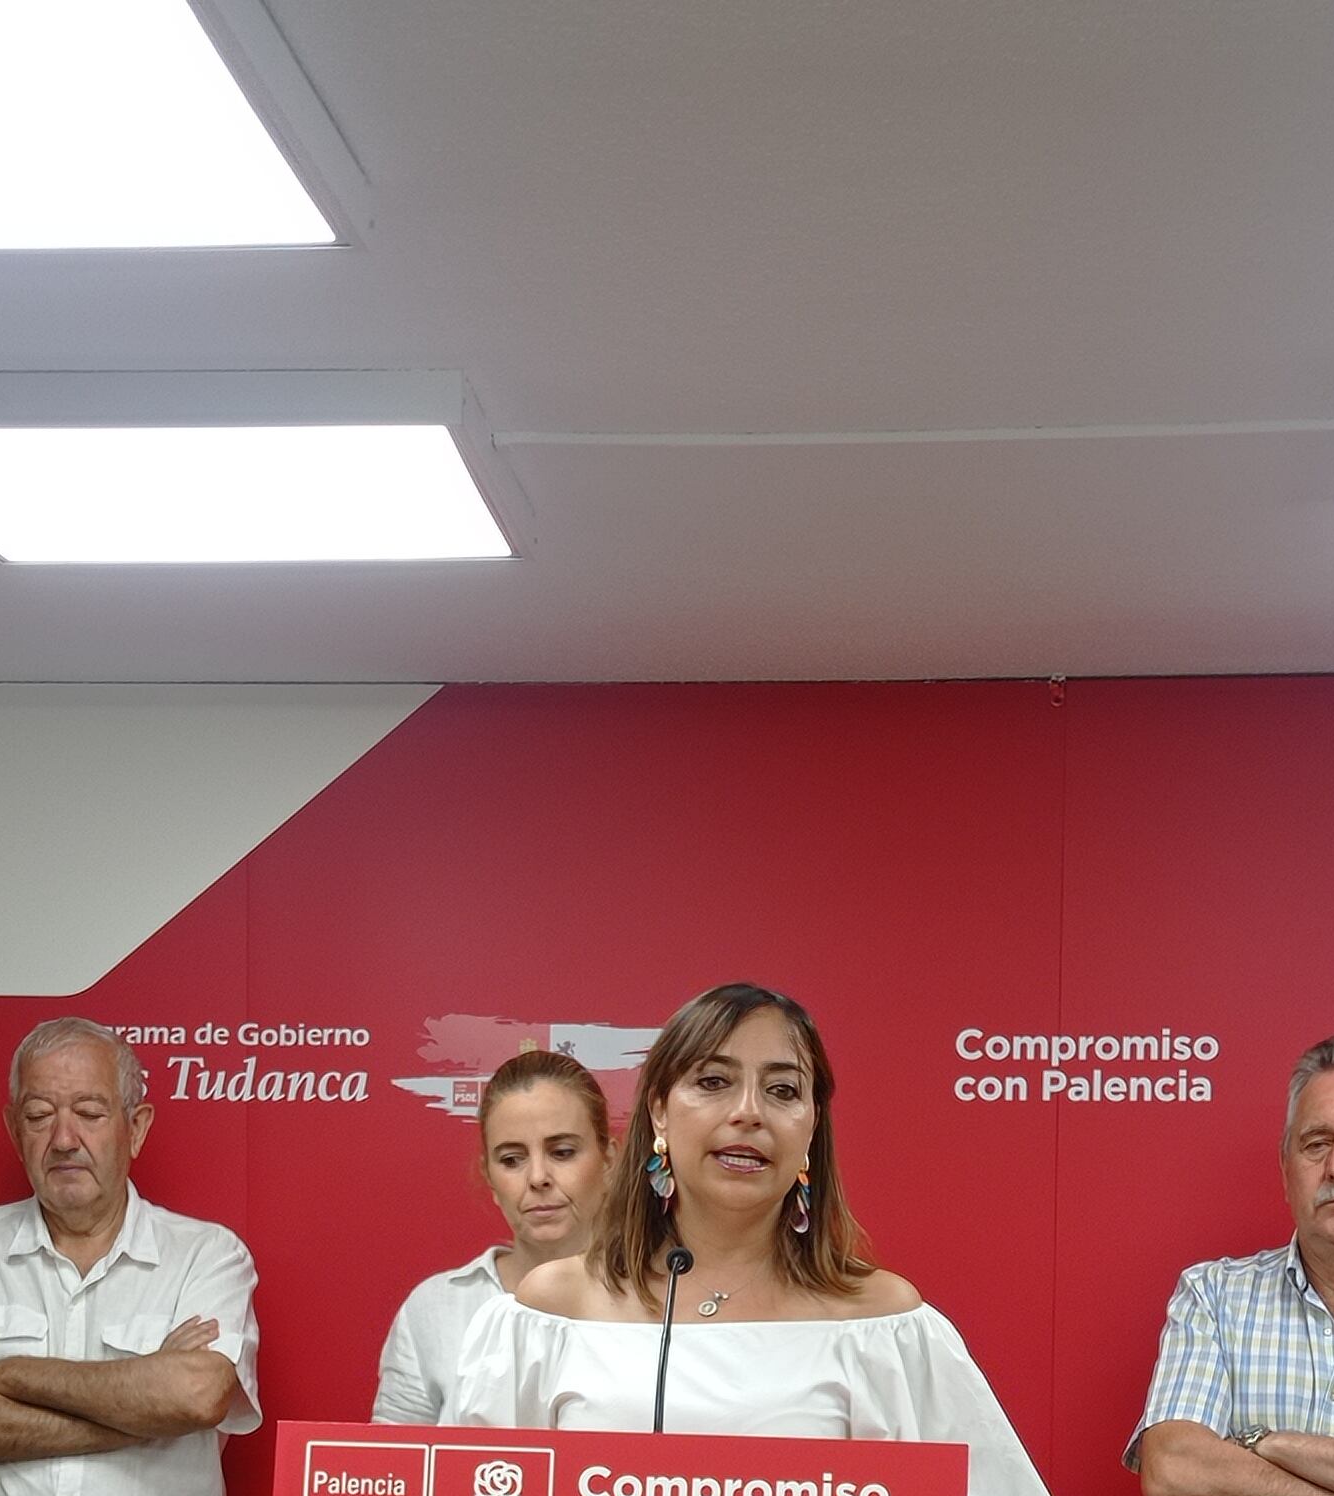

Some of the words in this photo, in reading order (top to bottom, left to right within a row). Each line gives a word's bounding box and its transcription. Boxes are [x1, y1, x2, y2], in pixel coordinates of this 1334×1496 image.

[194, 1022, 230, 1045] de
[237, 1022, 370, 1047] Gobierno
[955, 1028, 1220, 1067] Compromiso
[167, 1056, 369, 1102] Tudanca
[954, 1075, 1028, 1102] con
[1041, 1069, 1213, 1102] Palencia
[313, 1471, 406, 1496] Palencia
